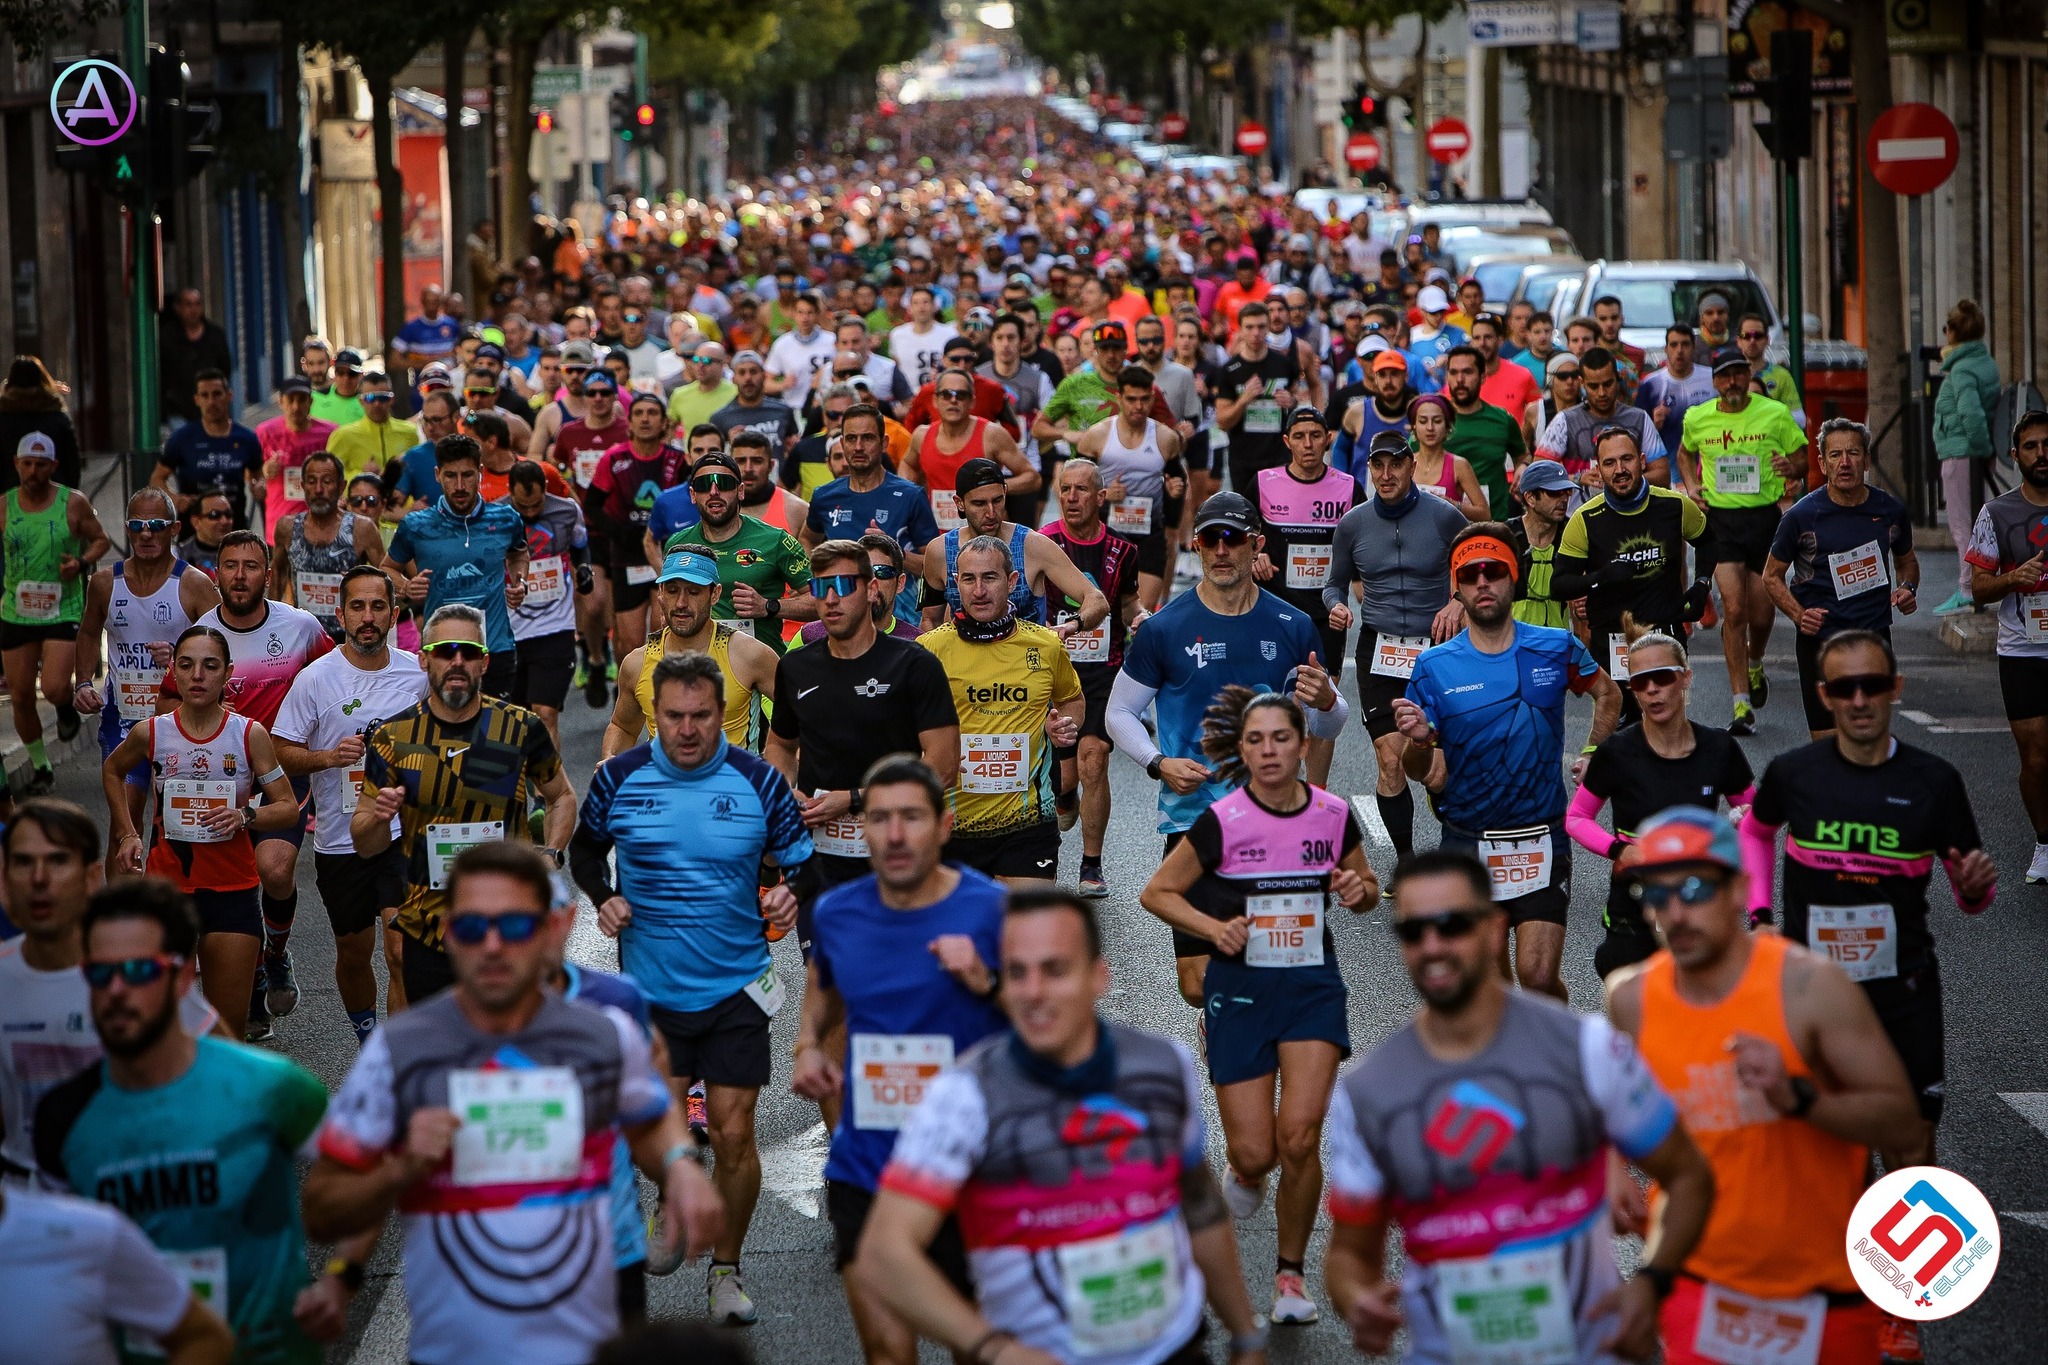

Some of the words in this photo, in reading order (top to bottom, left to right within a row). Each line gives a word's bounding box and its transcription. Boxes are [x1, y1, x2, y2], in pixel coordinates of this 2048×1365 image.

[1312, 500, 1347, 519] 30K
[1458, 542, 1498, 560] TERREX
[1296, 566, 1325, 577] 1142
[1840, 565, 1878, 587] 1052
[305, 593, 336, 605] 758
[1066, 639, 1100, 651] 570
[966, 683, 1028, 703] teika
[1455, 683, 1485, 694] BROOKS
[973, 763, 1017, 778] 482
[189, 799, 209, 808] PAULA
[1815, 819, 1900, 851] KM3
[1302, 840, 1335, 862] 30K
[1493, 866, 1540, 884] 908
[1256, 880, 1321, 889] CRONOMETRA
[1269, 931, 1304, 948] 1116
[1827, 943, 1878, 962] 1157
